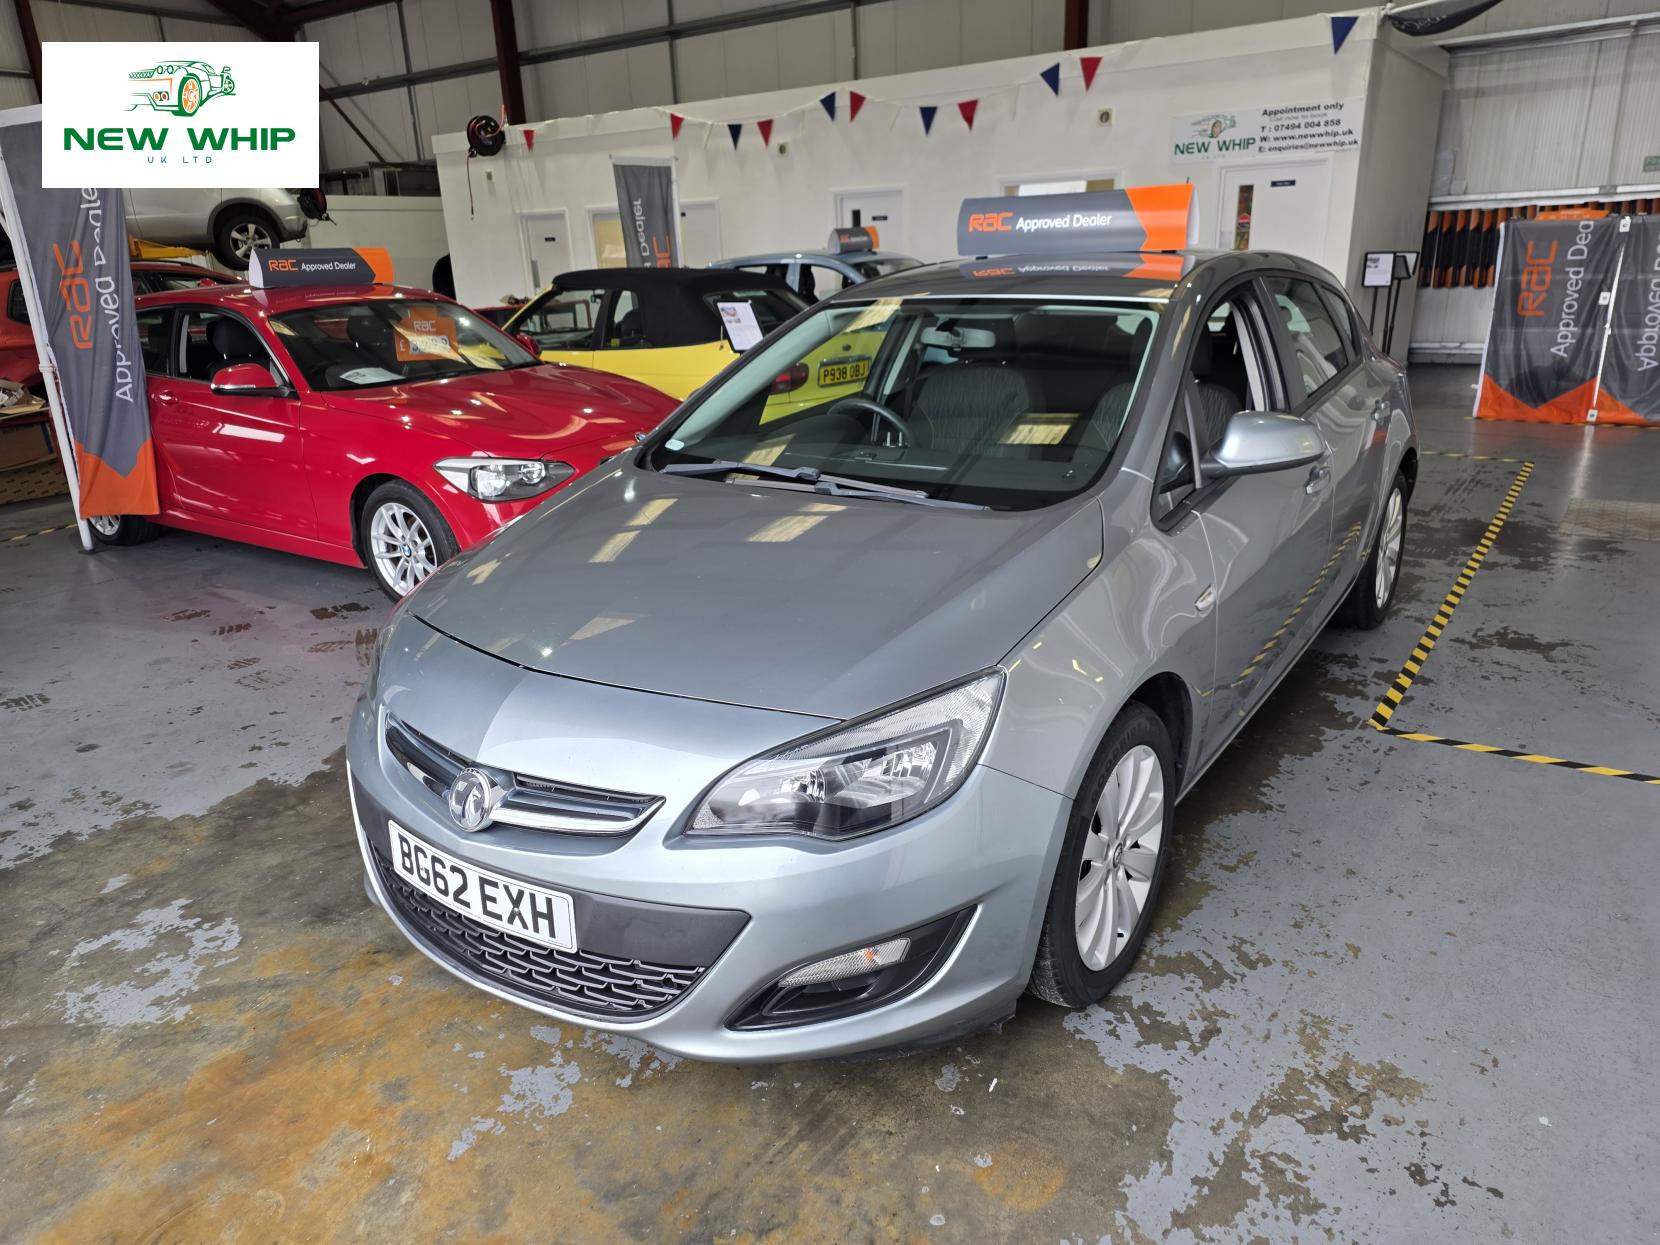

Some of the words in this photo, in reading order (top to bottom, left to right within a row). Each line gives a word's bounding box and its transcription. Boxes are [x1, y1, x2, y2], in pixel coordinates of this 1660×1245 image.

[1262, 104, 1321, 117] Appointment
[1324, 102, 1344, 112] only
[1273, 122, 1302, 132] 07494
[1304, 121, 1321, 129] 004
[1323, 118, 1341, 127] 858
[1259, 135, 1271, 143] W:
[1272, 129, 1354, 142] www.newwhip.uk
[1174, 141, 1211, 156] NEW
[1216, 136, 1256, 151] WHIP
[633, 198, 650, 257] Dealer
[1015, 215, 1070, 232] Approved
[1072, 213, 1112, 227] Dealer
[301, 261, 333, 272] Approved
[334, 261, 356, 270] Dealer
[1550, 267, 1585, 357] Approved
[823, 365, 848, 383] P938
[398, 831, 471, 909] BG62
[478, 875, 557, 939] EXH
